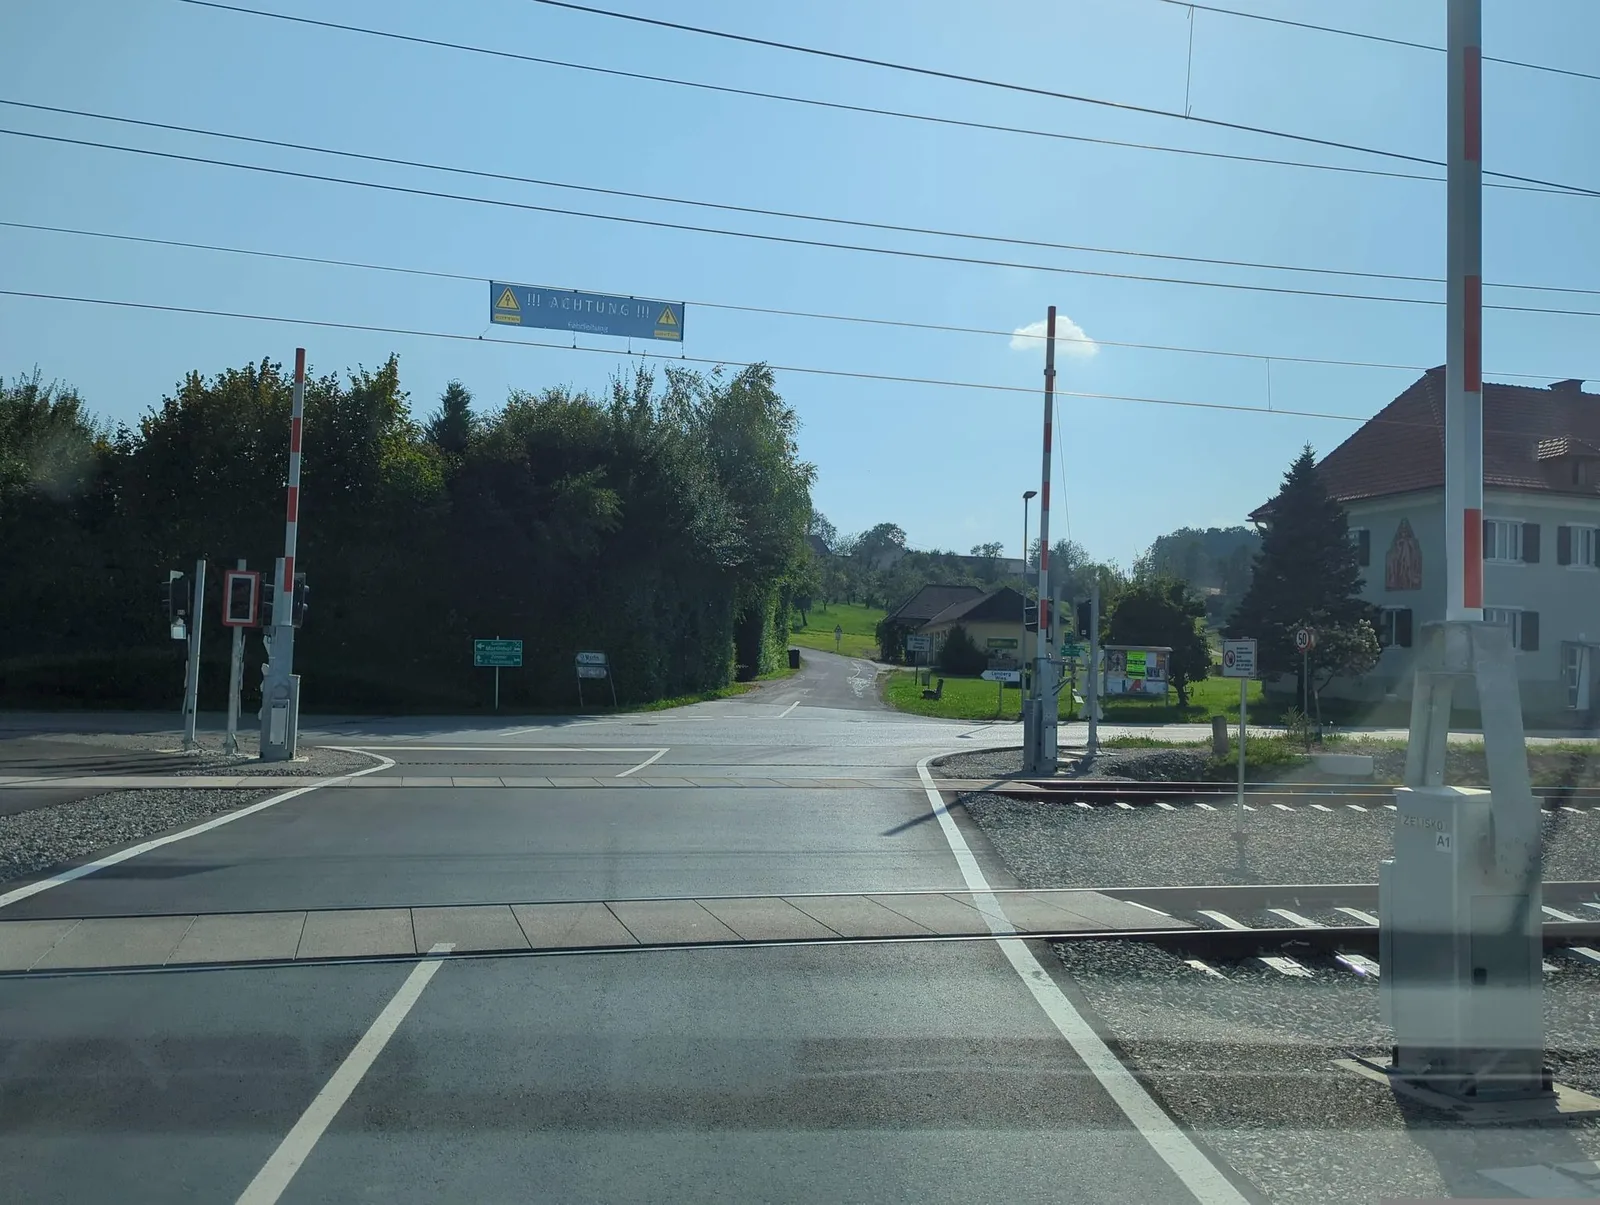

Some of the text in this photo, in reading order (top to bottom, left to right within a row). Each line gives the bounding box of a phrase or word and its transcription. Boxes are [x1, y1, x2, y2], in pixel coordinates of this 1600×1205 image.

[550, 296, 629, 316] ACHTUNG
[1298, 632, 1307, 646] 50
[1436, 835, 1450, 848] A1
